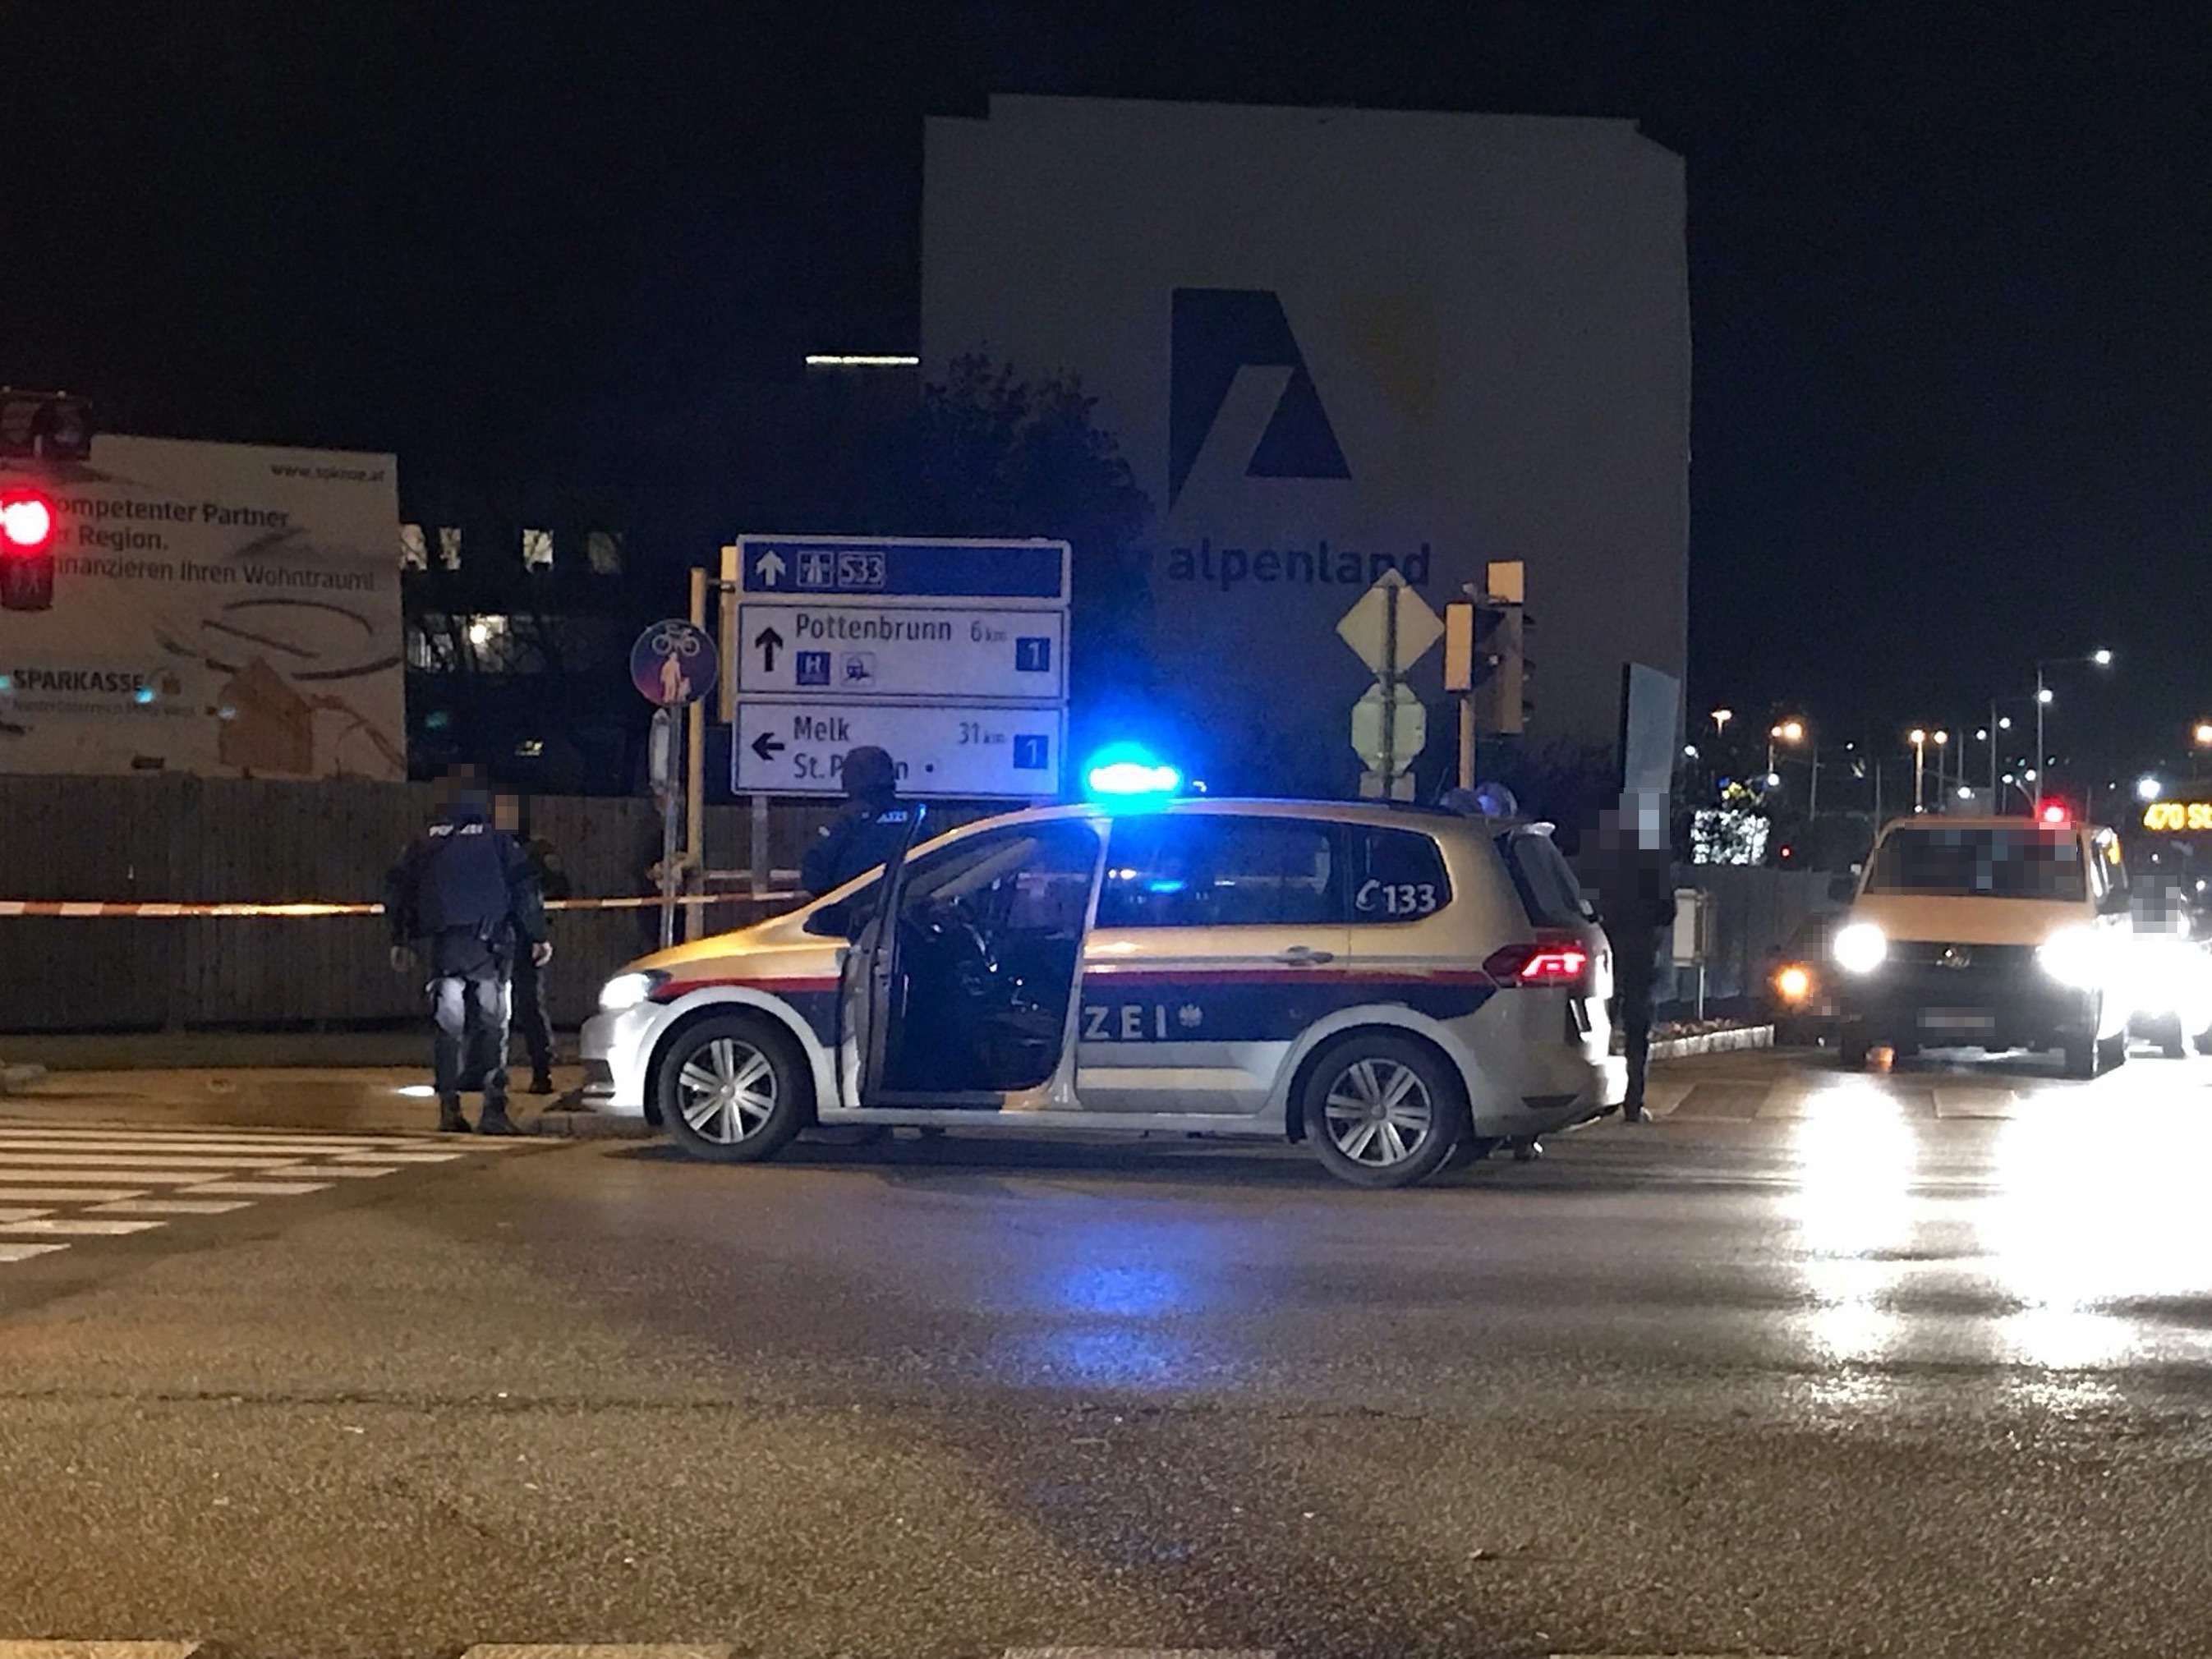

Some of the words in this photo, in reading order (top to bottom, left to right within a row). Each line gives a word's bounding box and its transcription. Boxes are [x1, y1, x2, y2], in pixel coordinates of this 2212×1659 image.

[55, 498, 197, 523] ompetenter
[202, 503, 289, 528] Partner
[78, 524, 169, 551] Region.
[180, 561, 237, 585] Ihren
[245, 563, 375, 592] Wohntraum!
[839, 554, 883, 585] S33
[1168, 538, 1431, 592] alpenland
[795, 613, 952, 642] Pottenbrunn
[12, 669, 145, 693] SPARKASSE
[793, 715, 851, 742] Melk
[793, 752, 825, 779] St.
[2143, 802, 2185, 830] 470
[1382, 883, 1437, 914] 133
[1085, 1003, 1168, 1041] ZEI
